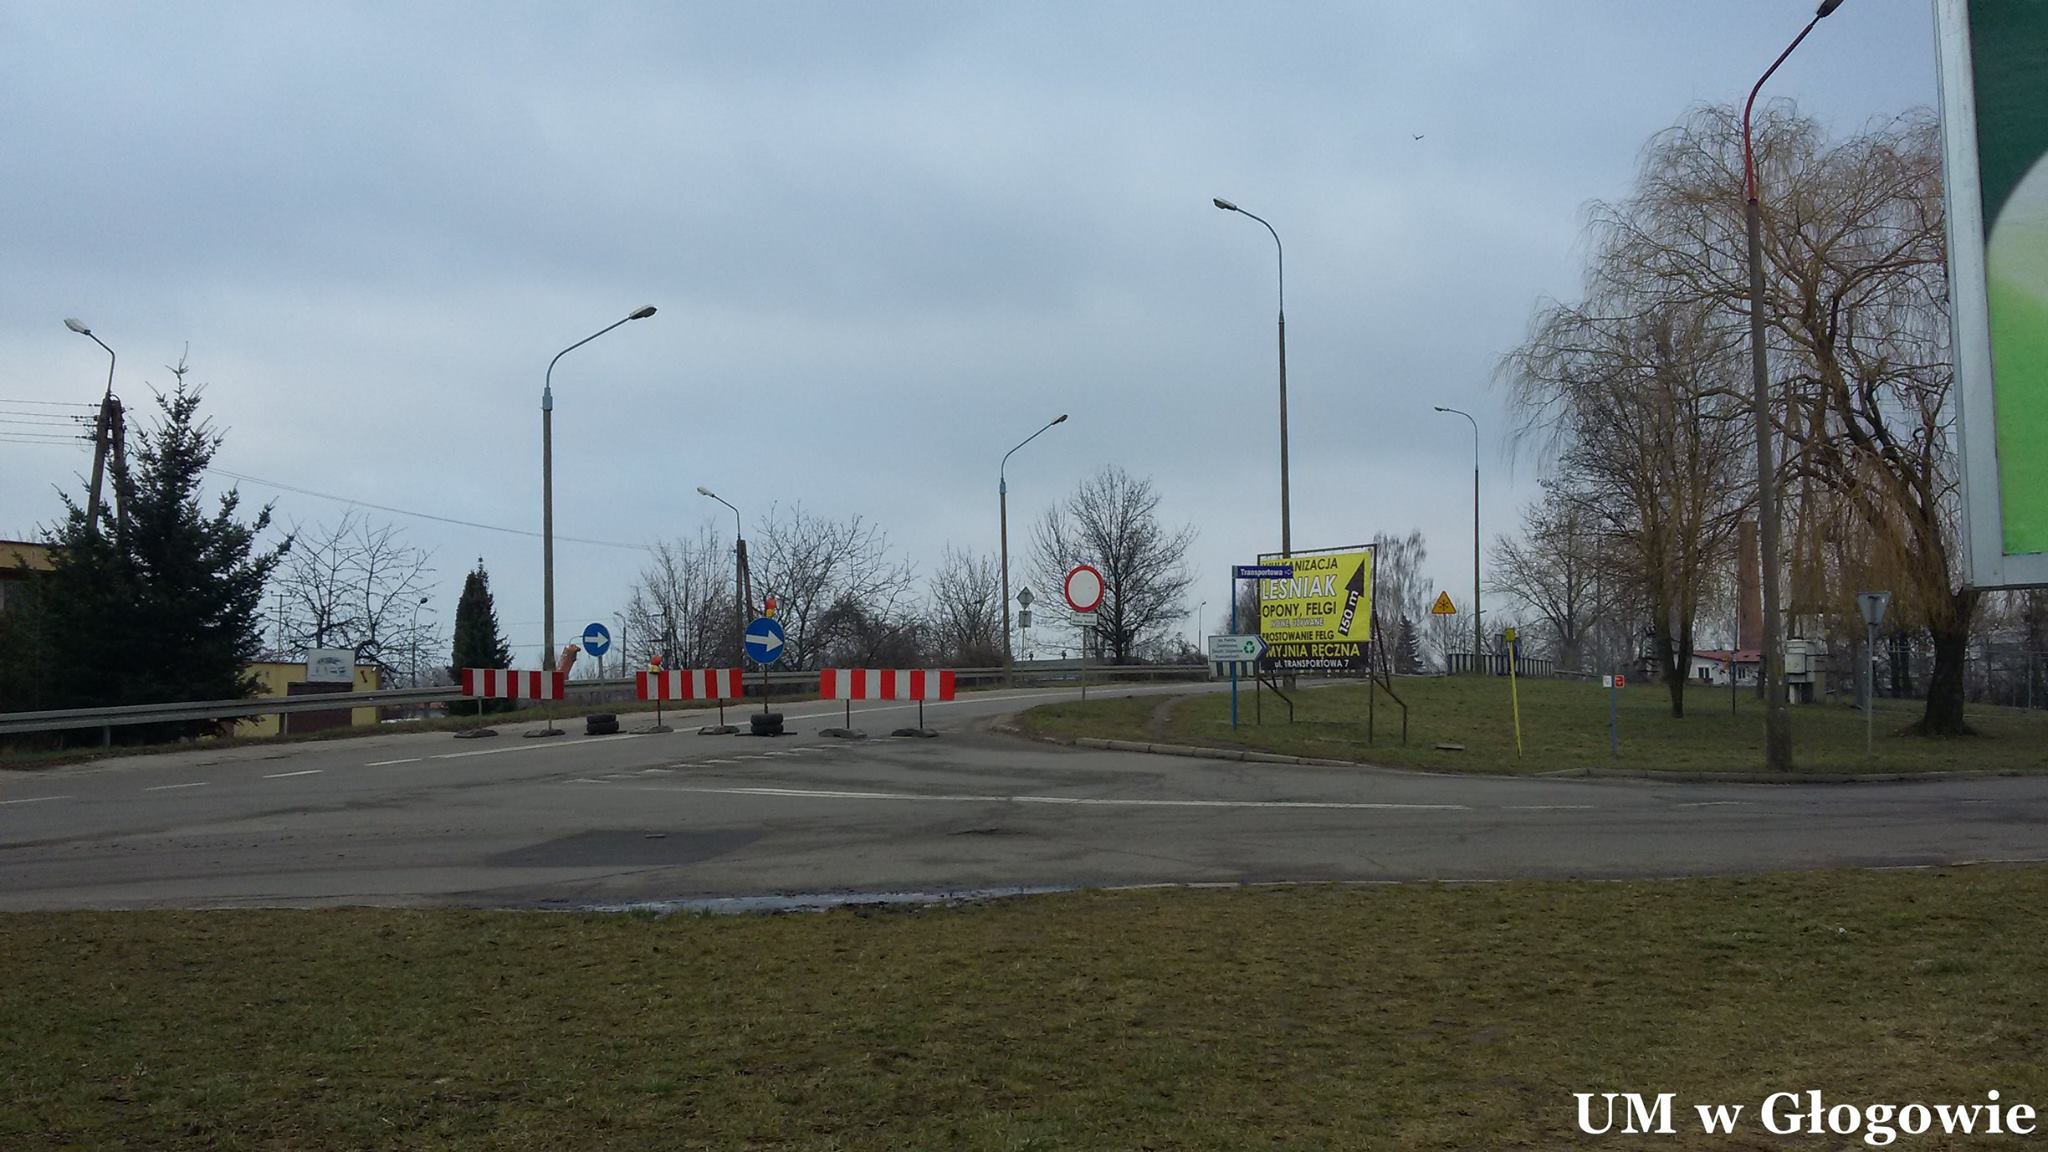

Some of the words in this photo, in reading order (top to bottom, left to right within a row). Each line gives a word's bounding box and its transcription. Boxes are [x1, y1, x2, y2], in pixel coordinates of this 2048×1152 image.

[1263, 558, 1338, 572] NIZACJA
[1240, 568, 1283, 577] Transportowa
[1262, 603, 1303, 618] OPONY,
[1306, 601, 1337, 615] FELGI
[1339, 609, 1353, 632] 150
[1349, 590, 1359, 606] m
[1262, 631, 1313, 642] PROSTOWANIE
[1315, 630, 1335, 640] FELG
[1266, 644, 1308, 658] MYJNIA
[1311, 643, 1360, 660] RĘCZNA
[1284, 659, 1343, 668] TRANSPORTOWA
[1344, 659, 1350, 667] 7
